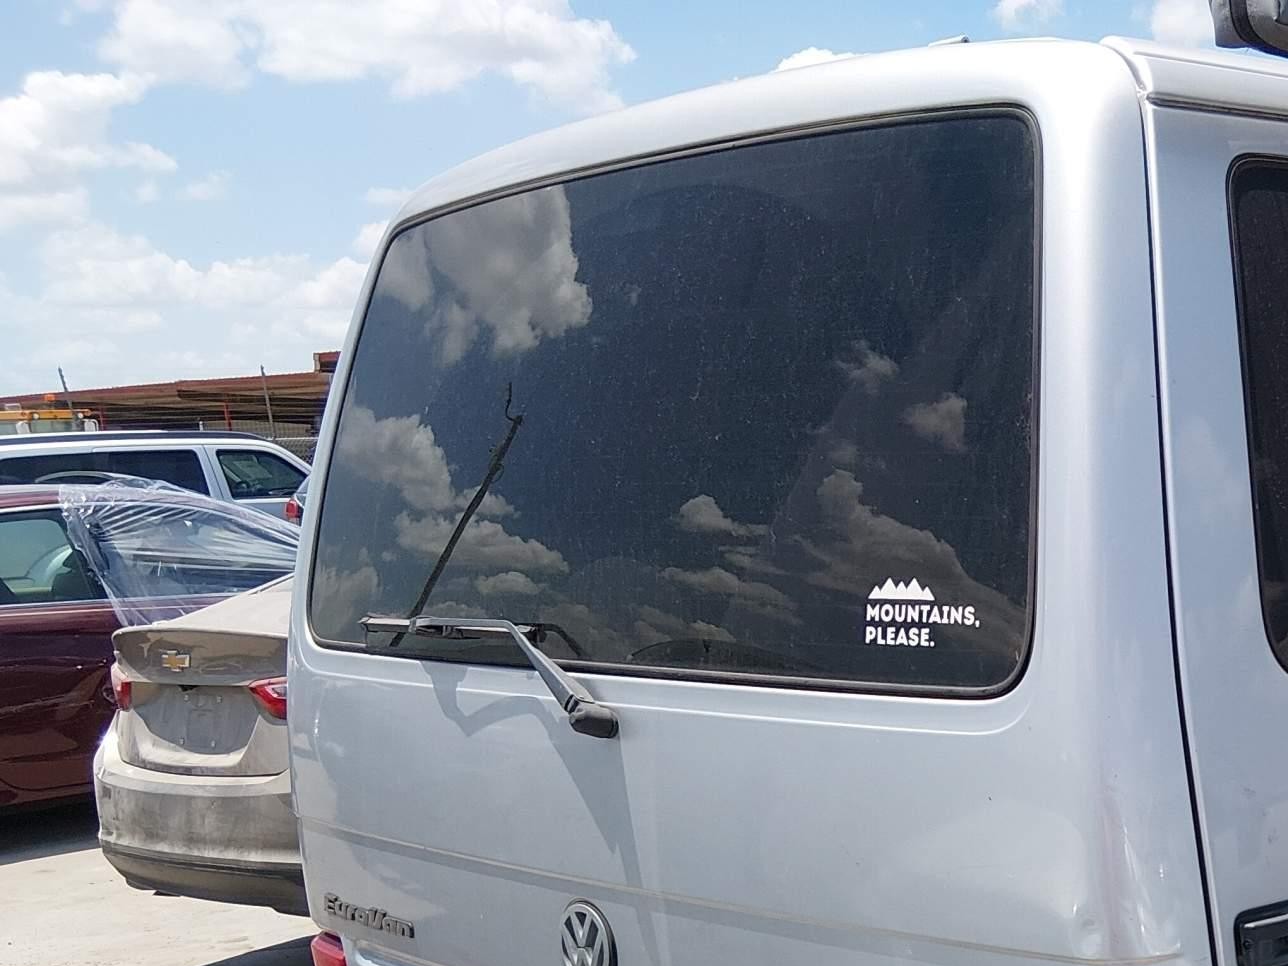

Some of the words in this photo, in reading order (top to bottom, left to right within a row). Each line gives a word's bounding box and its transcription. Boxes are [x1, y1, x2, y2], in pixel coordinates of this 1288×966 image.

[866, 604, 980, 628] MOUNTAINS,
[865, 626, 935, 647] PLEASE.
[324, 892, 415, 938] EuroVan
